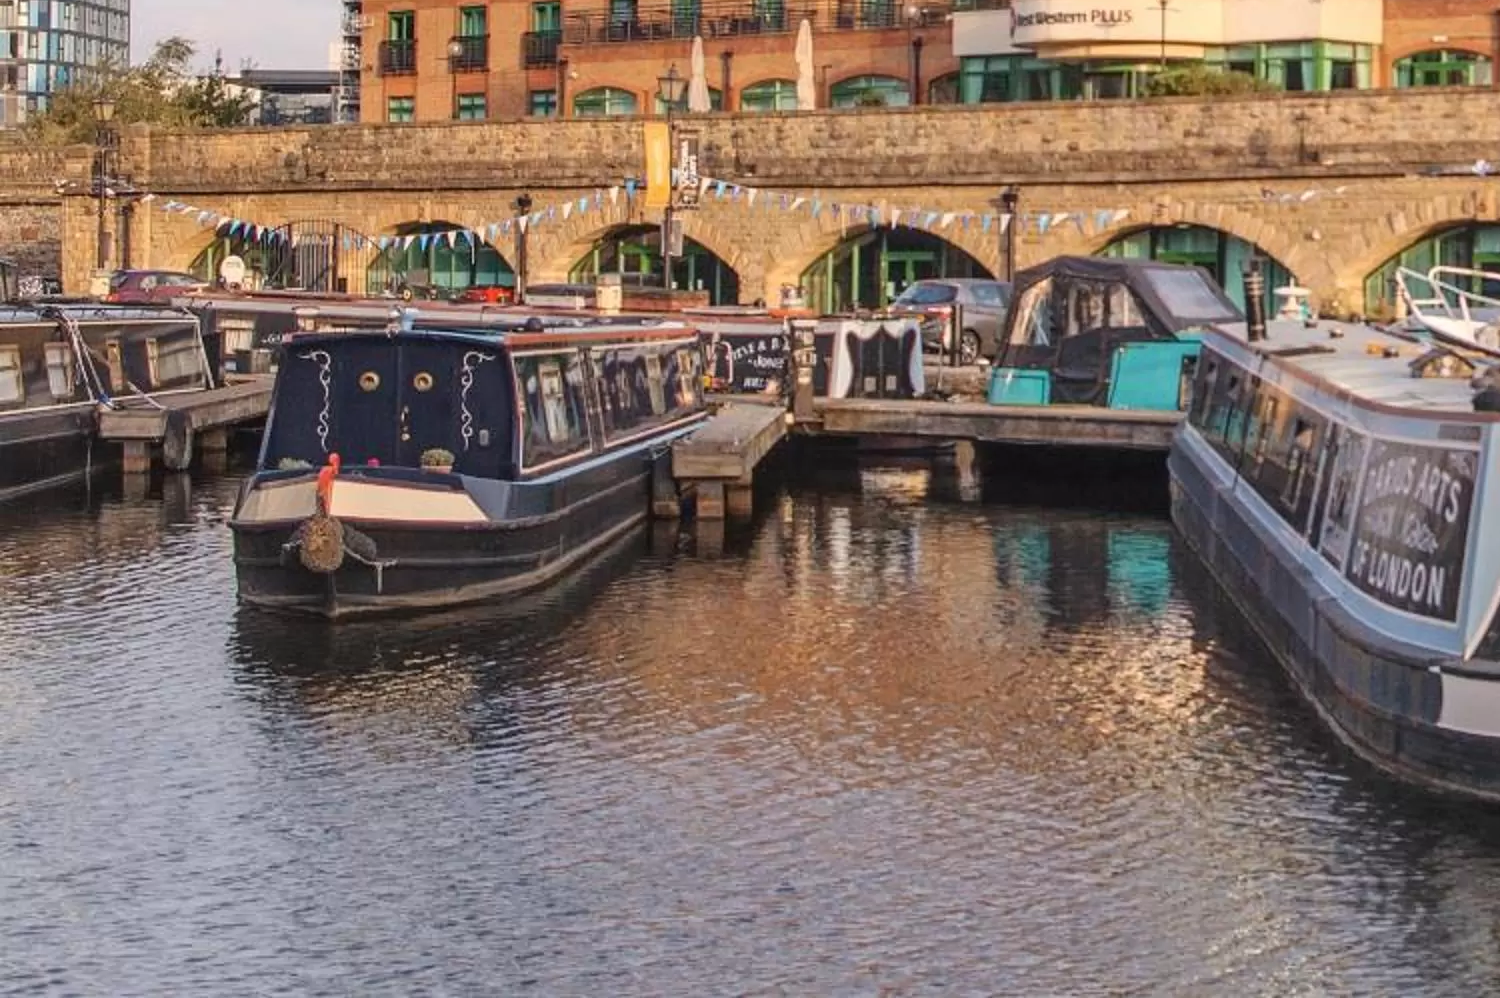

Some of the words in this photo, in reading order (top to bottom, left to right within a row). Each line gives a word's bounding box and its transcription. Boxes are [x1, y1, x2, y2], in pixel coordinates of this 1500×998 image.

[1091, 9, 1133, 23] PLUS
[1413, 462, 1462, 523] ARTS
[1368, 552, 1445, 609] LONDON
